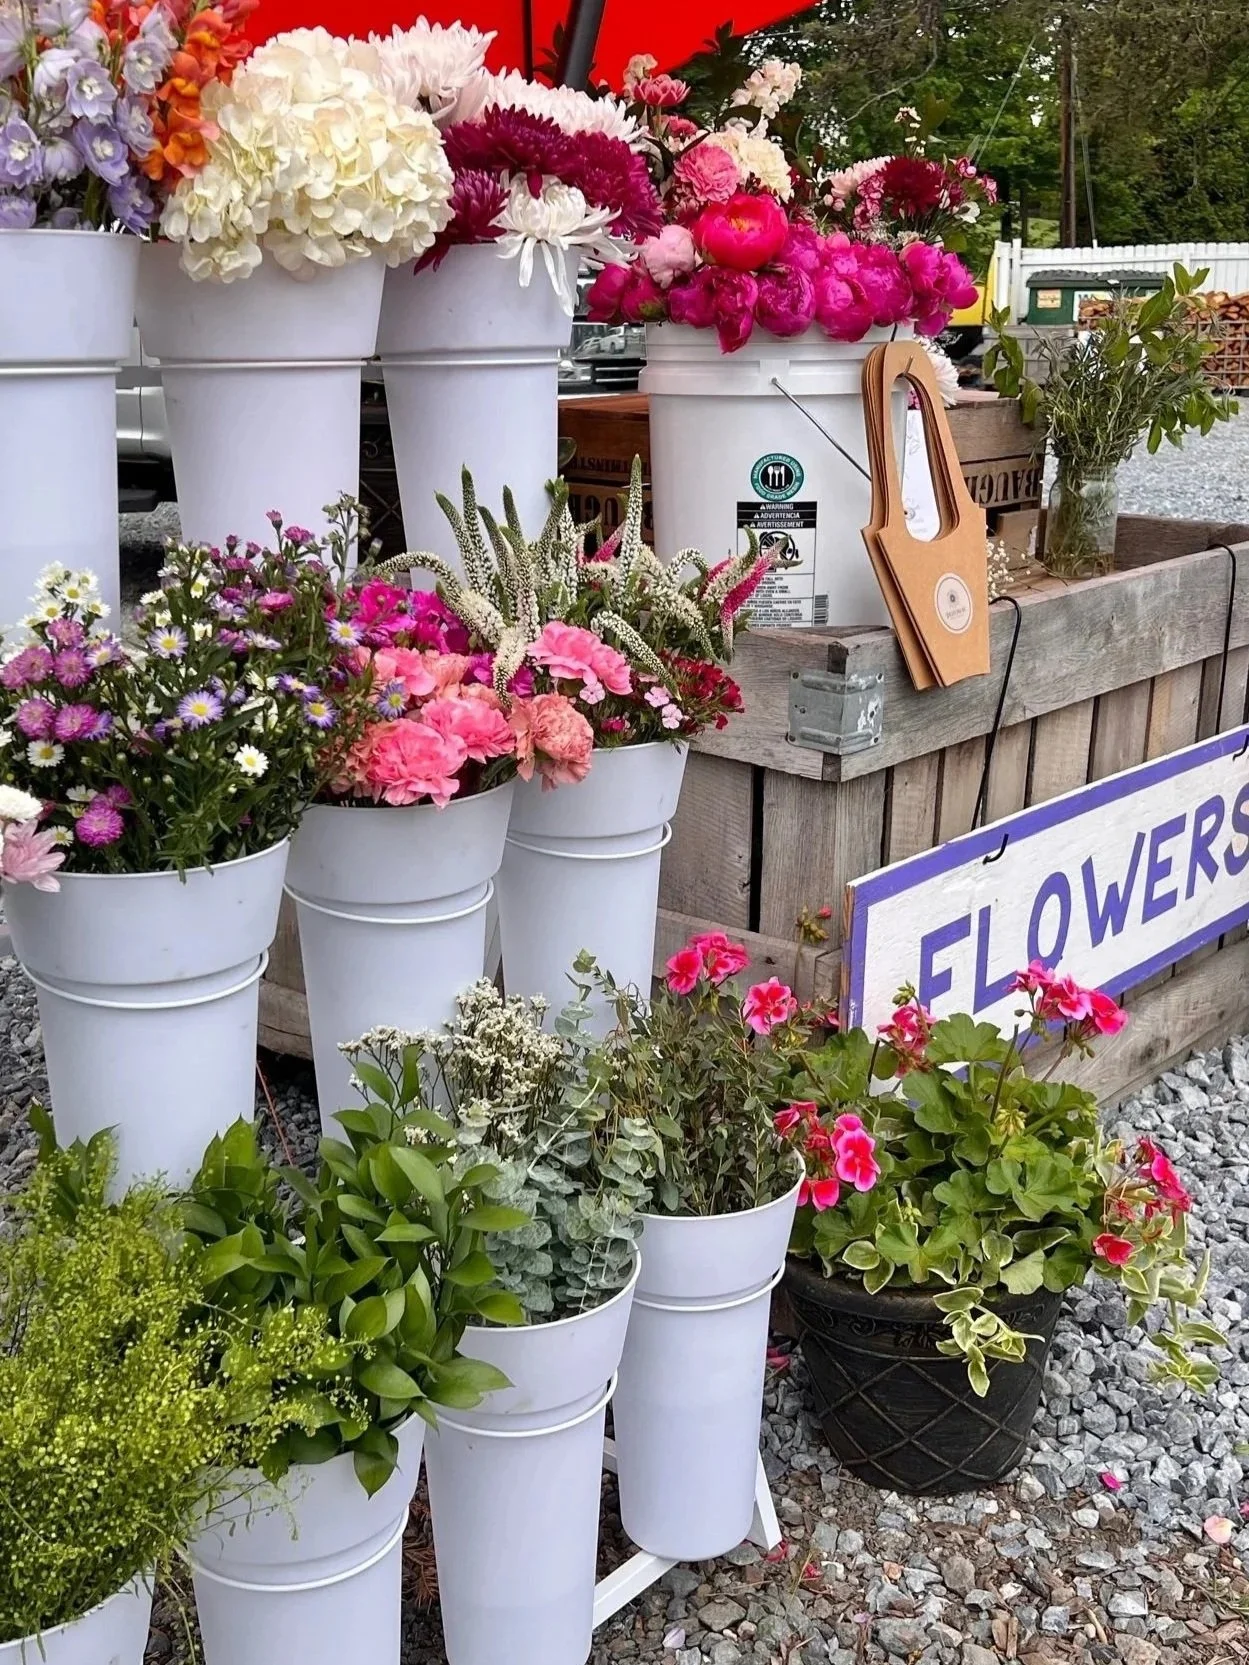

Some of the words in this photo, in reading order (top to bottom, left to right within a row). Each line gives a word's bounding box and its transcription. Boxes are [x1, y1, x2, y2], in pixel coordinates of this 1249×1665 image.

[752, 455, 791, 479] MANUFACTURED
[790, 460, 802, 477] USING
[754, 482, 766, 497] FOOD
[786, 481, 800, 497] RESIN
[918, 782, 1249, 1015] FLOWERS
